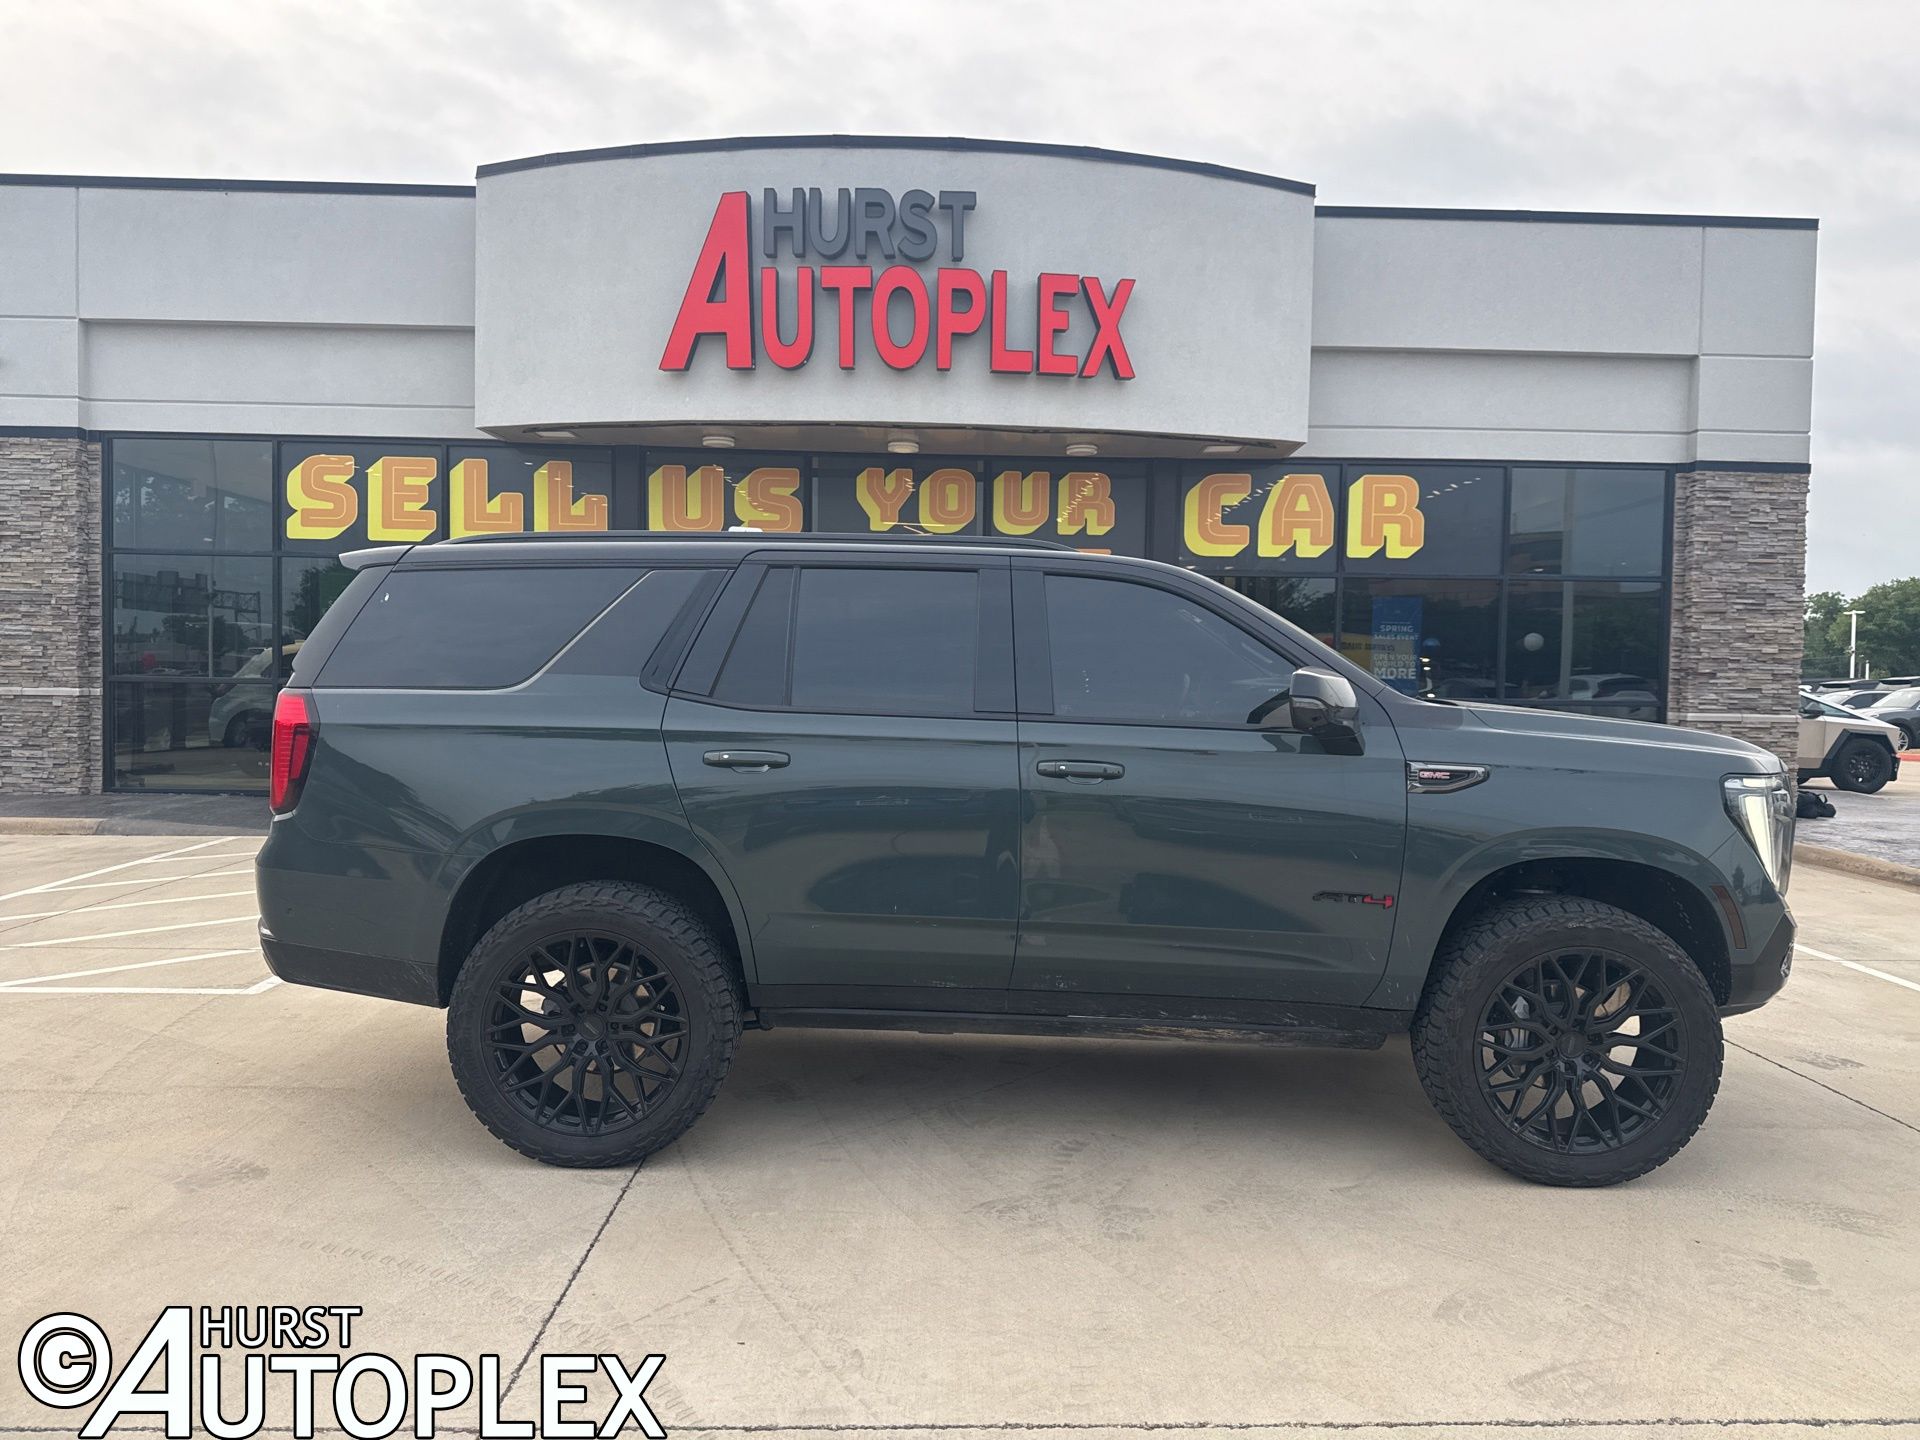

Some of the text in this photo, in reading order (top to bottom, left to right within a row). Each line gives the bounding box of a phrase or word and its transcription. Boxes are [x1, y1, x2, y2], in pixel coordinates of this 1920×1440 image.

[762, 187, 977, 262] HURST
[658, 190, 1137, 381] AUTOPLEX
[286, 453, 1426, 559] SELL US YOUR CAR
[1379, 625, 1414, 633] SPRING
[1374, 668, 1416, 679] MORE
[1419, 771, 1450, 780] GMC
